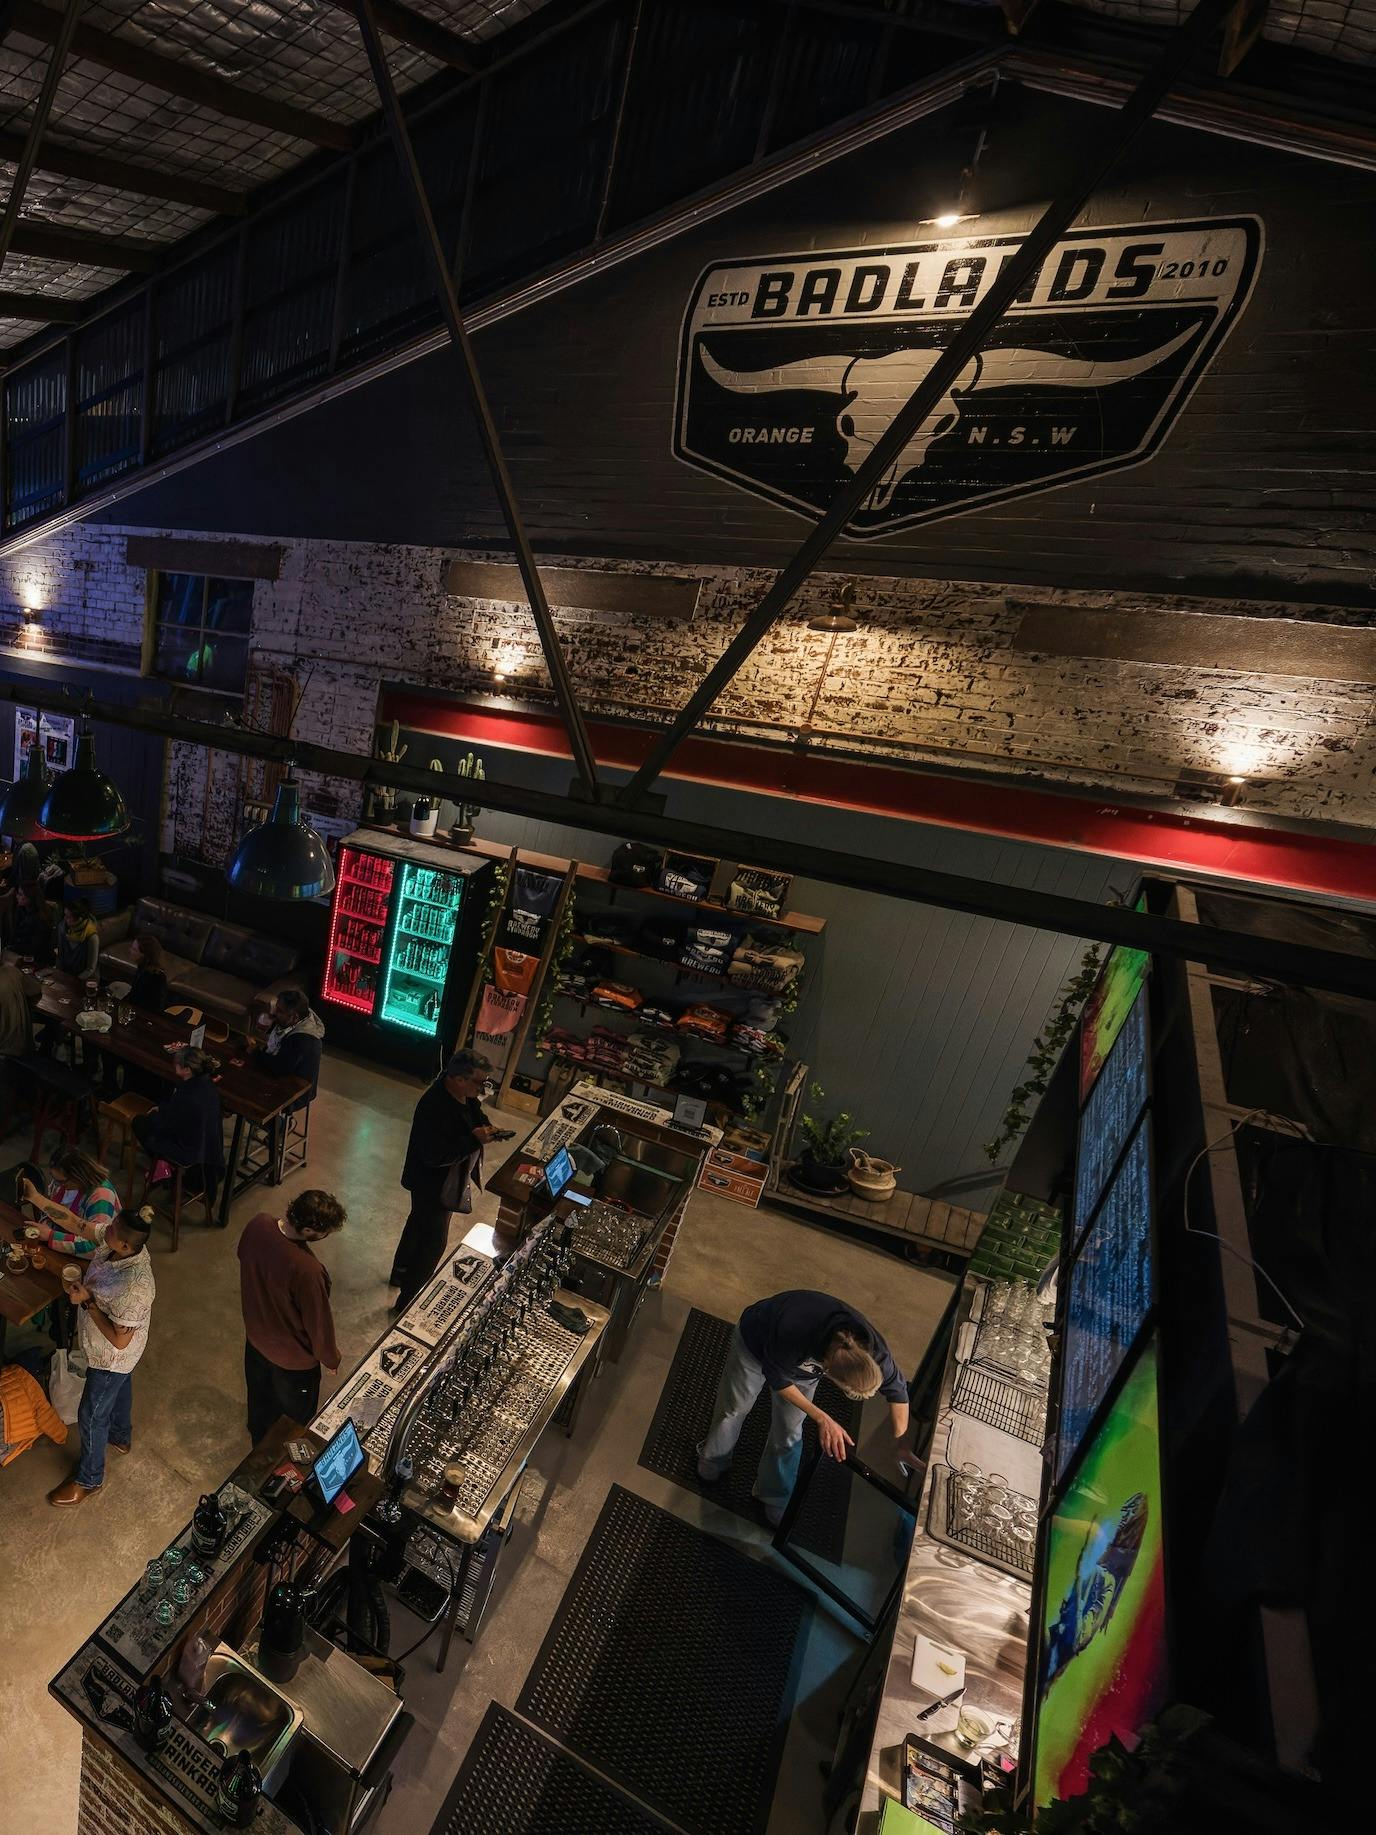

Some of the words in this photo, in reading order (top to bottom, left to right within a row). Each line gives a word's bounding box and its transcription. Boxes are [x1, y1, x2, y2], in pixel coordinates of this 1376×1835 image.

[707, 291, 750, 308] ESTD
[1161, 259, 1228, 280] 2010
[727, 427, 815, 445] ORANGE
[223, 1518, 256, 1556] BADLANDS
[101, 1665, 138, 1699] BADLAN
[159, 1739, 220, 1798] RINKAB
